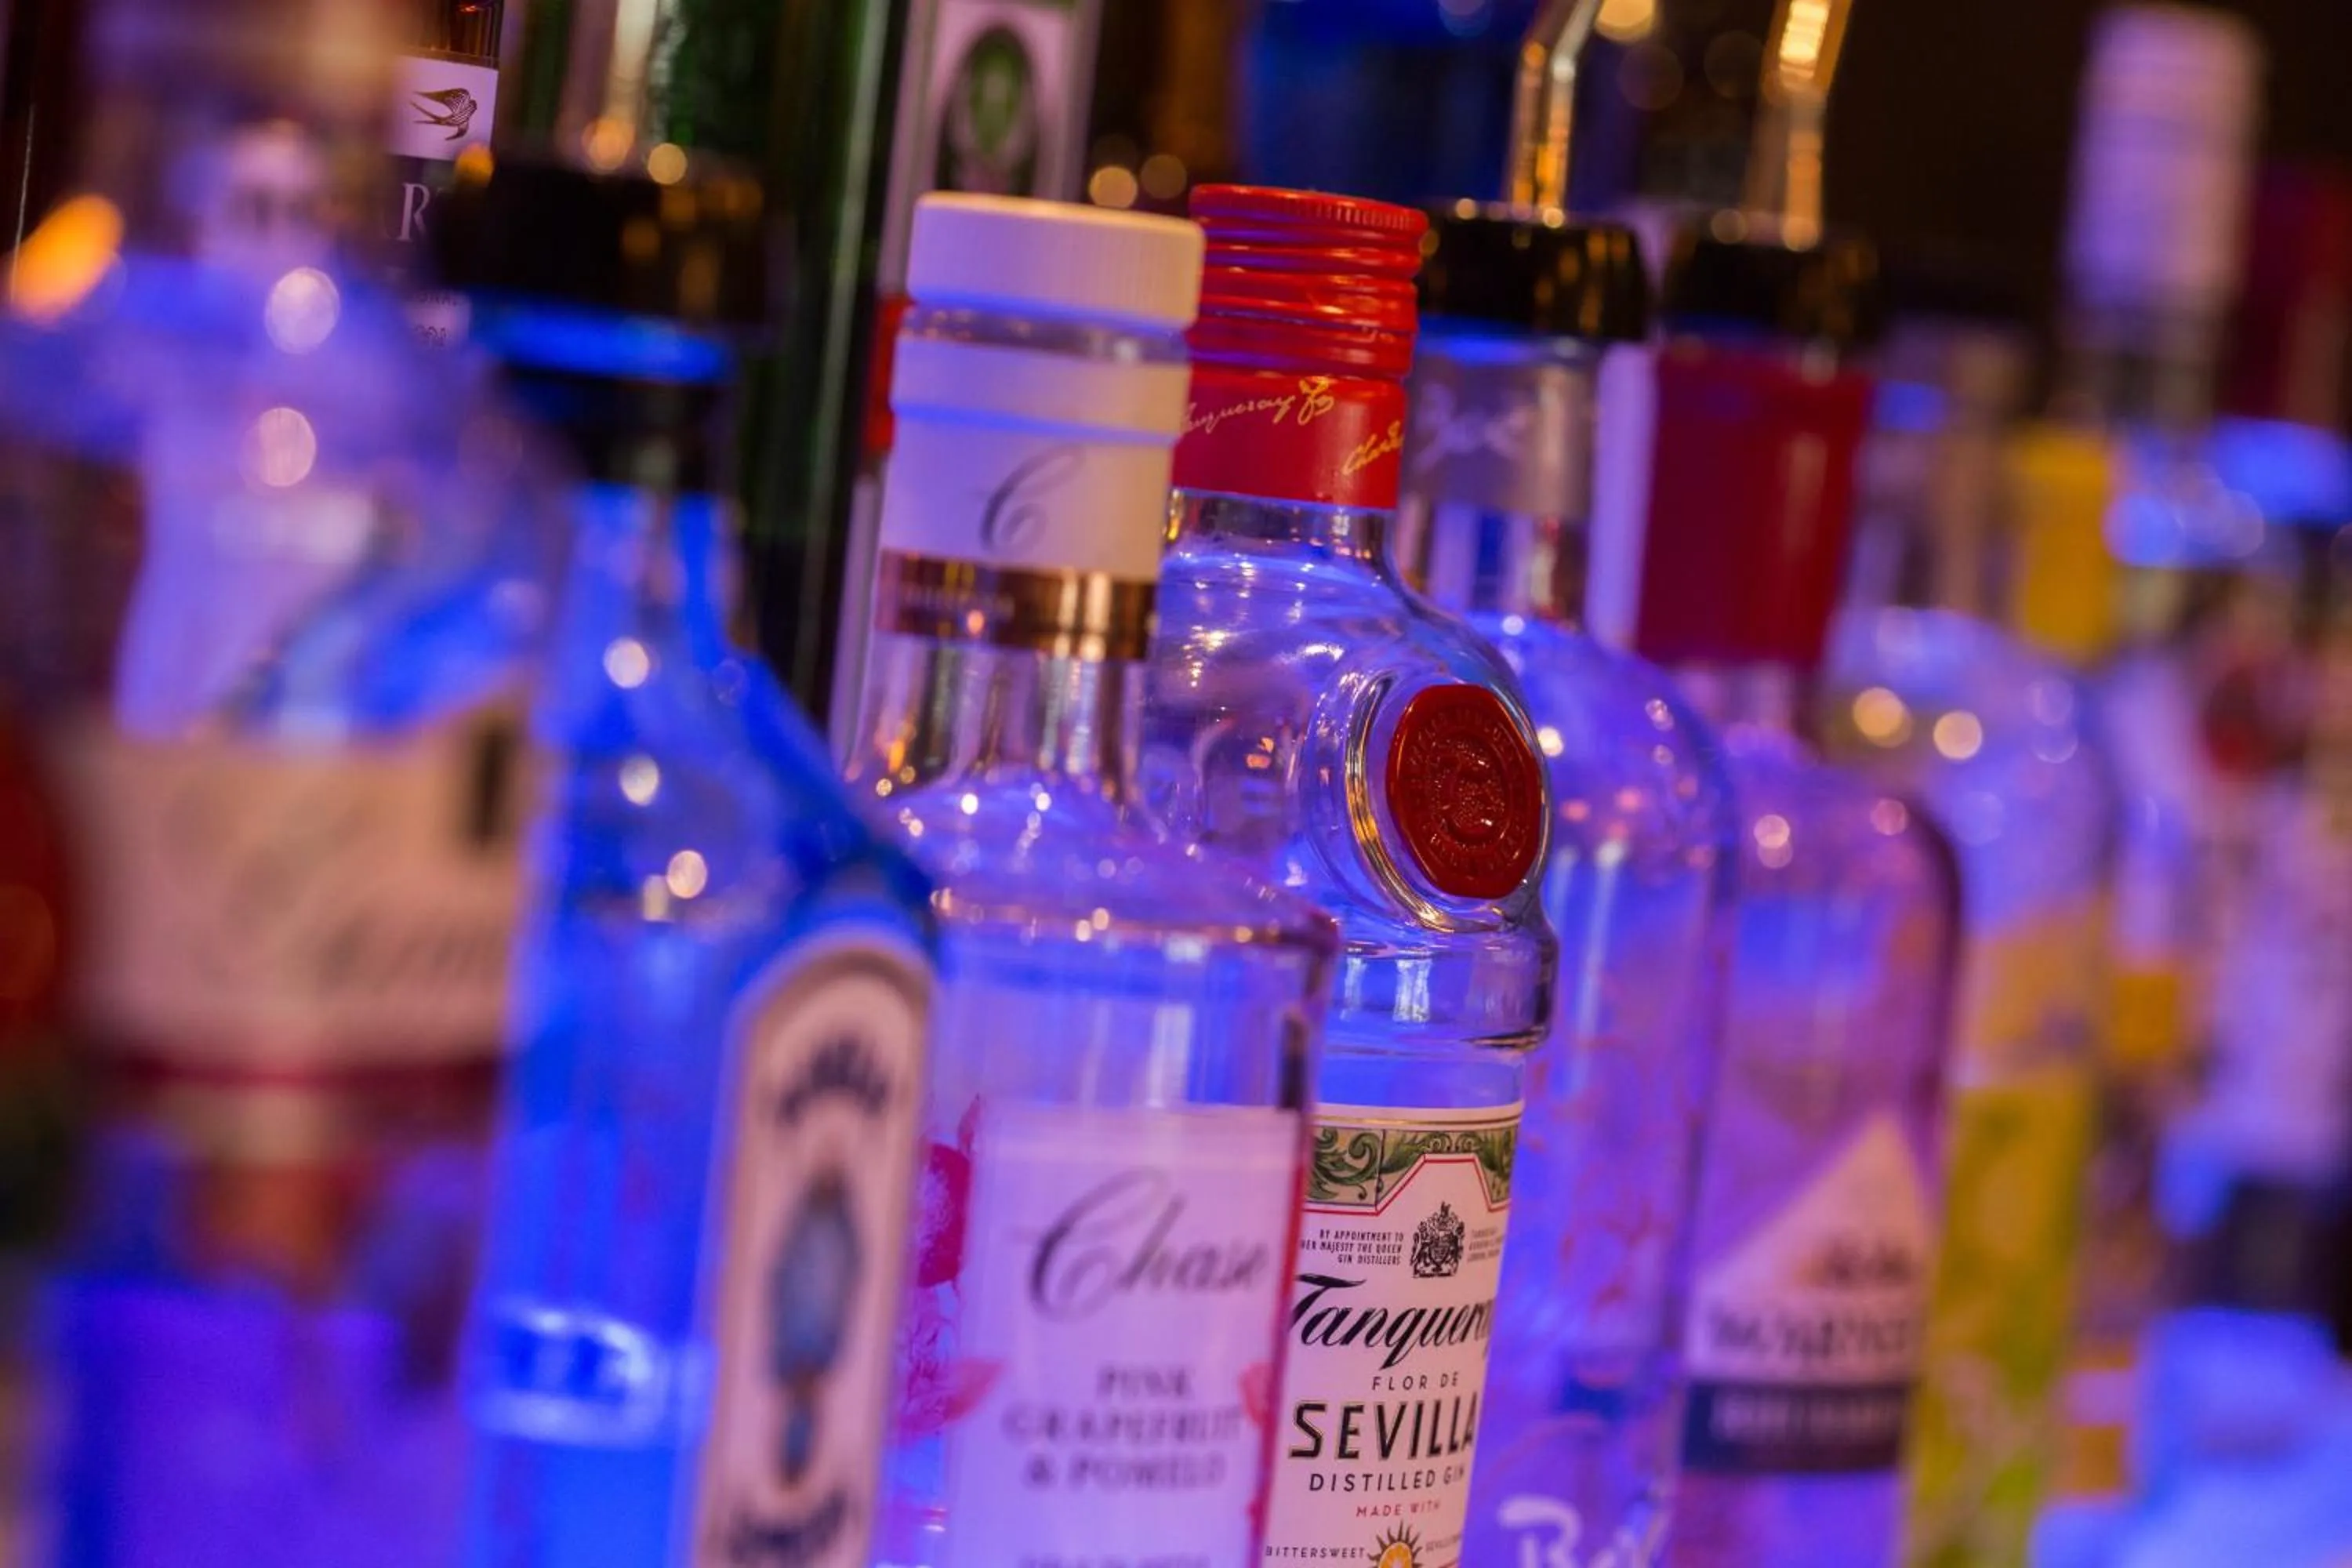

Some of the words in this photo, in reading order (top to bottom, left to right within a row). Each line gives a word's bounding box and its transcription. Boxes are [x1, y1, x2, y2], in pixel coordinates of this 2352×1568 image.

[1319, 1229, 1330, 1239] BY
[1334, 1230, 1392, 1242] APPOINTMENT
[1395, 1232, 1404, 1242] TO
[1319, 1240, 1354, 1254] MAJESTY
[1356, 1243, 1373, 1254] THE
[1376, 1243, 1402, 1254] QUEEN
[1338, 1253, 1352, 1265] GIN
[1357, 1254, 1402, 1266] DISTILLERS
[1371, 1374, 1428, 1392] FLOR
[1439, 1371, 1460, 1388] DE
[1288, 1391, 1478, 1461] SEVILLA
[1308, 1470, 1436, 1492] DISTILLED
[1443, 1465, 1465, 1486] GIN
[1356, 1504, 1403, 1518] MADE
[1411, 1500, 1441, 1514] WITH
[1265, 1545, 1366, 1559] BITTERSWEET
